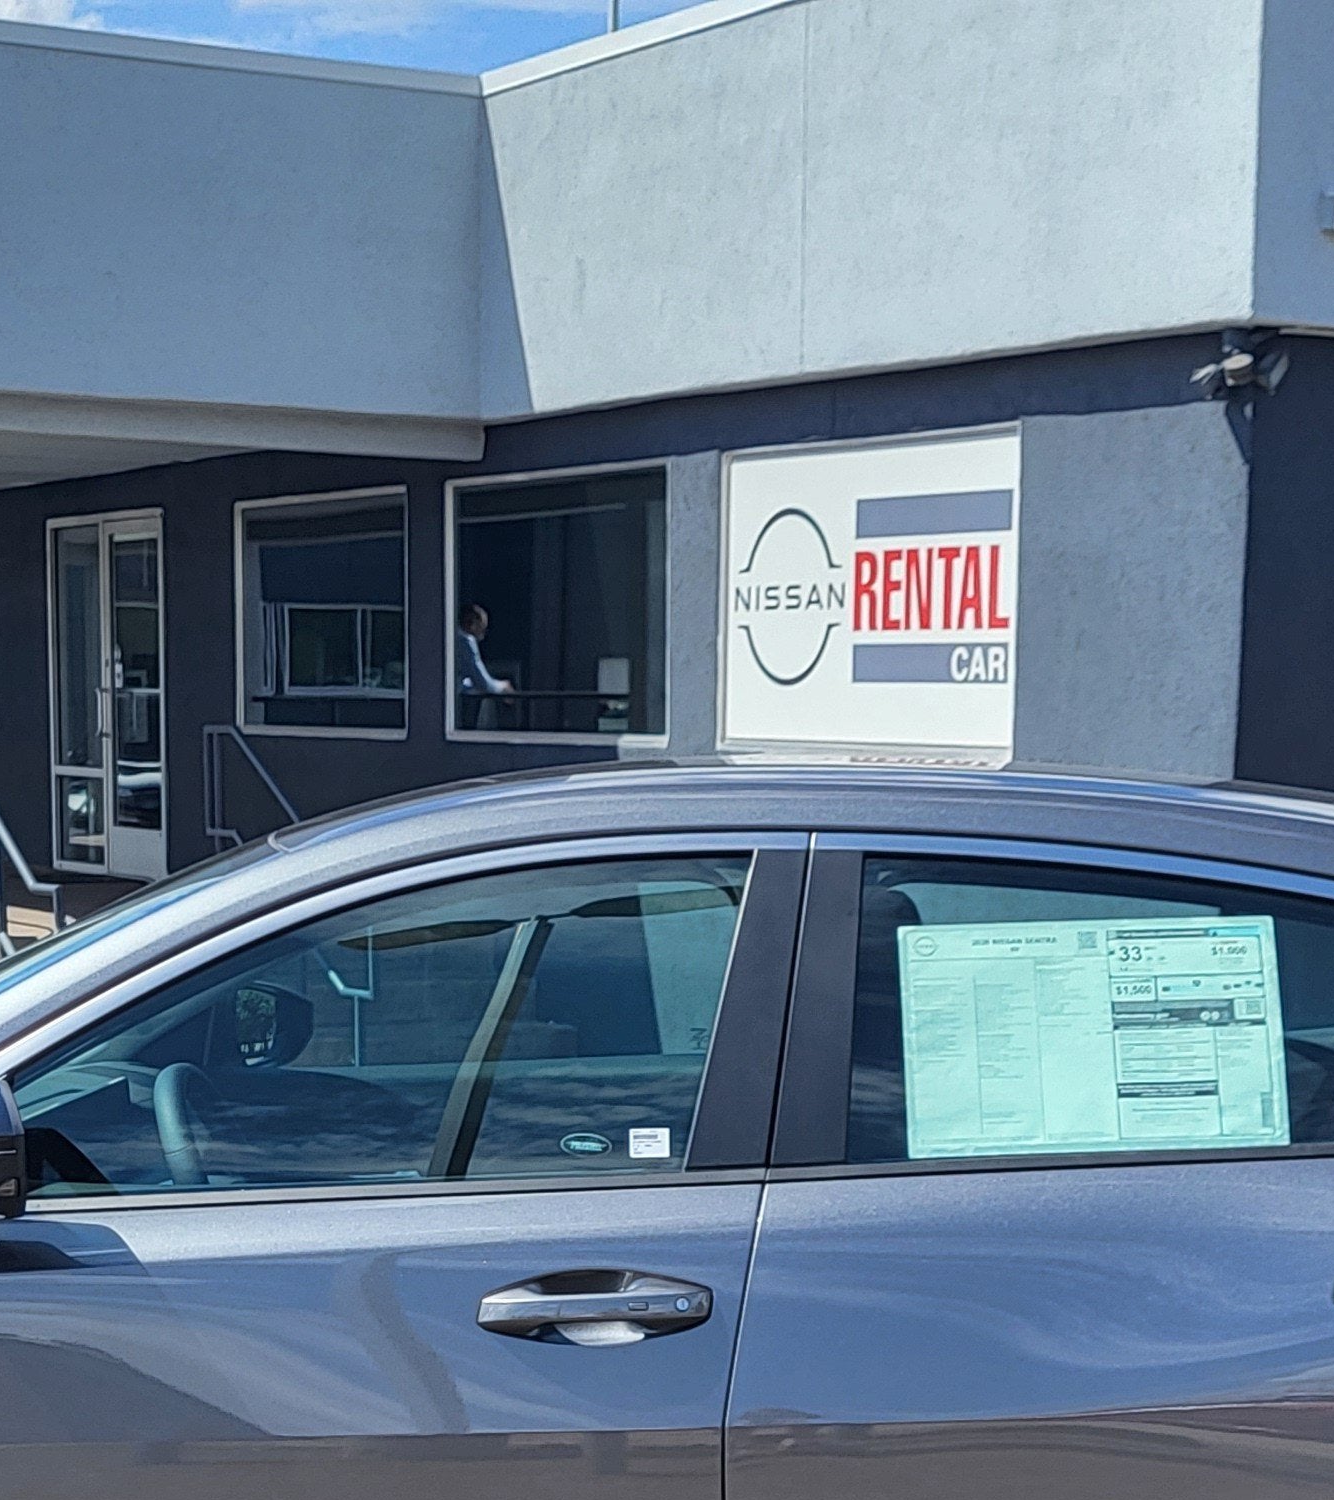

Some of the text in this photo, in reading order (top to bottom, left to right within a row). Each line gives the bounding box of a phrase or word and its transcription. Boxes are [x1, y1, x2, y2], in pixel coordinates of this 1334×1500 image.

[734, 582, 846, 611] NISSAN
[852, 544, 1011, 632] RENTAL
[950, 646, 1007, 682] CAR
[1119, 946, 1143, 962] 33
